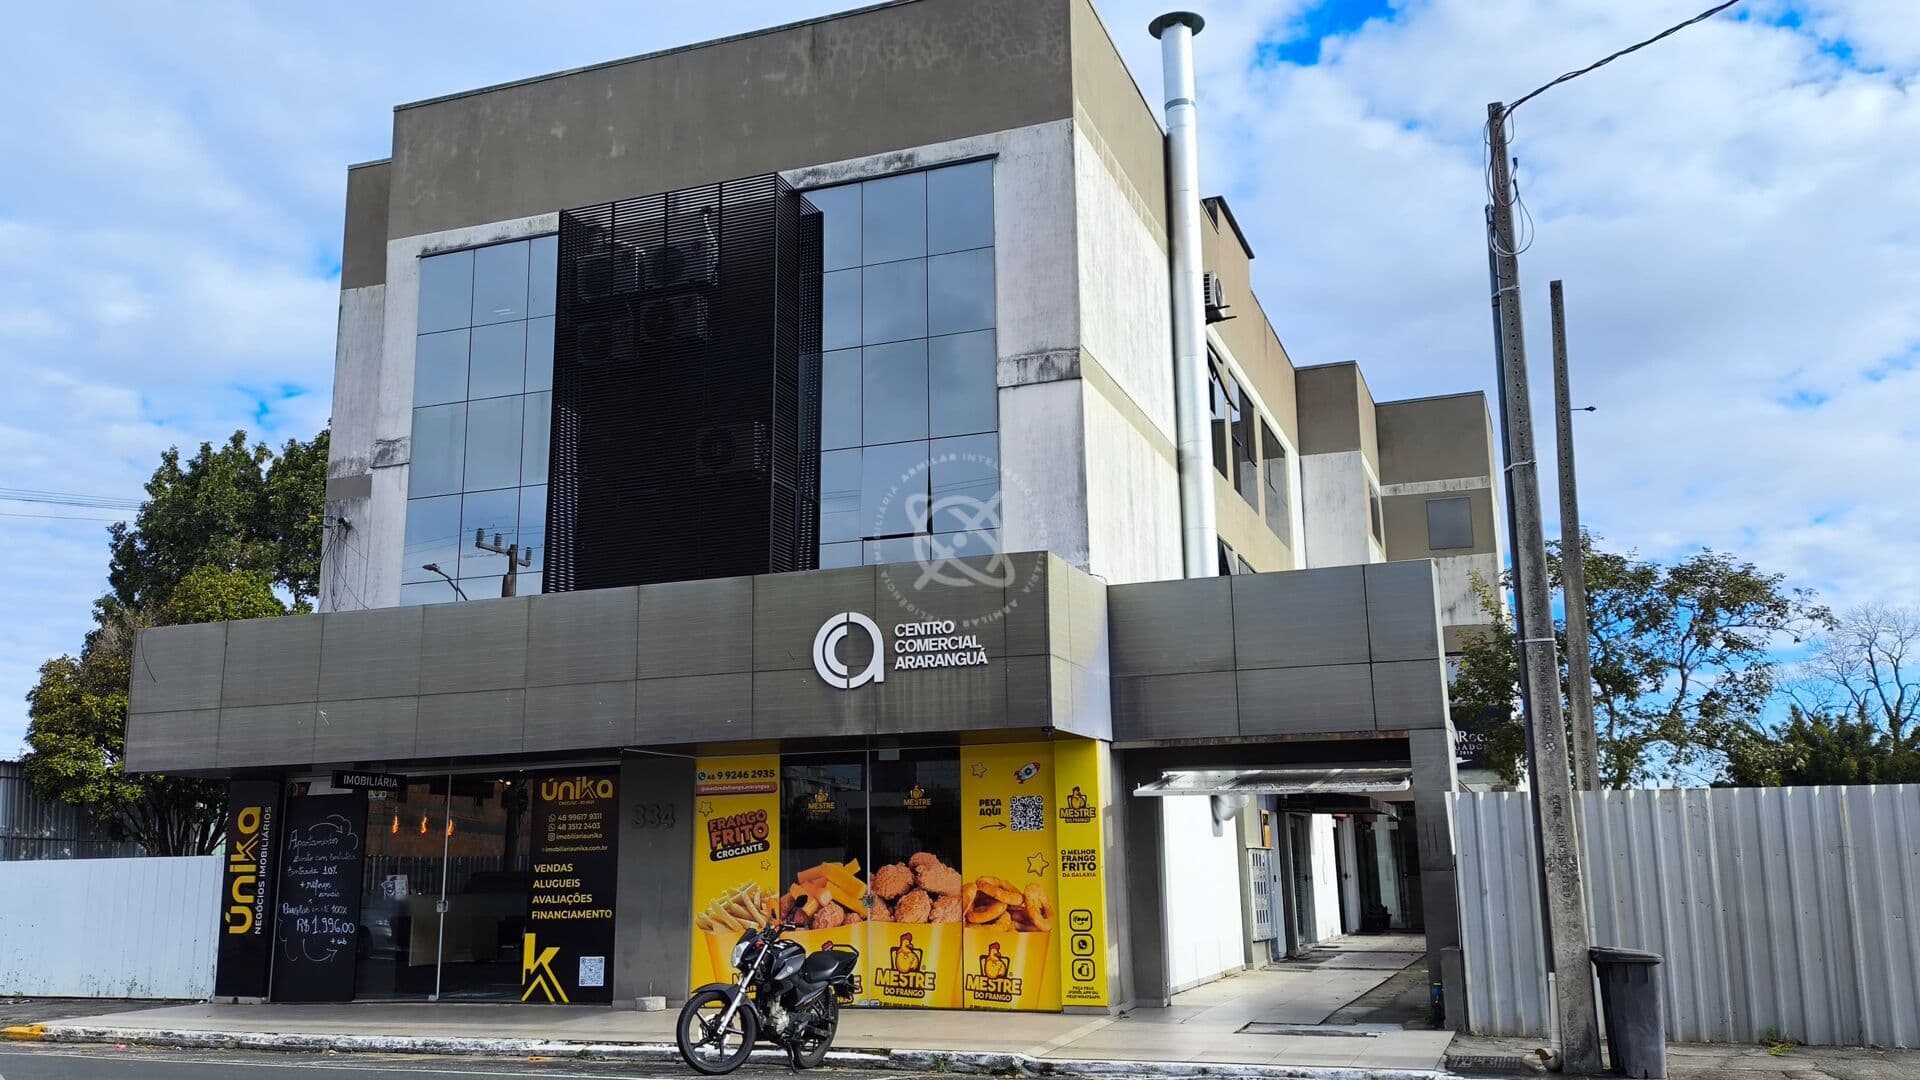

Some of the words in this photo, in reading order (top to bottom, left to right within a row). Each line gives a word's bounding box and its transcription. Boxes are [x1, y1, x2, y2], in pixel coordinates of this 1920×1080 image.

[894, 620, 955, 637] CENTRO
[894, 635, 982, 654] COMERCIAL
[894, 648, 988, 670] ARARANGUÁ
[717, 771, 723, 780] 9
[725, 769, 750, 780] 9246
[752, 769, 776, 779] 2935
[343, 775, 398, 788] IMOBILIÁRIA
[807, 801, 836, 811] MESTRE
[903, 798, 932, 806] MESTRE
[979, 799, 1002, 809] PEÇA
[979, 807, 1002, 817] AQUI
[1060, 807, 1096, 818] MESTRE
[709, 809, 767, 832] FRANGO
[557, 823, 567, 831] 48
[584, 822, 601, 830] 2403
[710, 821, 769, 850] FRITO
[259, 806, 272, 877] IMOBILIÁRIOS
[716, 843, 764, 860] CROCANTE
[322, 865, 338, 875] 10%
[534, 863, 574, 873] VENDAS
[1062, 862, 1097, 872] FRITO
[533, 878, 581, 889] ALUGUEIS
[532, 892, 593, 905] AVALIAÇÕES
[254, 880, 265, 935] NEGÓCIOS
[531, 909, 613, 920] FINANCIAMENTO
[876, 968, 936, 990] MESTRE
[966, 974, 1022, 995] MESTRE
[884, 987, 895, 996] DO
[895, 988, 925, 998] FRANGO
[974, 992, 985, 1000] DO
[985, 993, 1012, 1002] FRANGO
